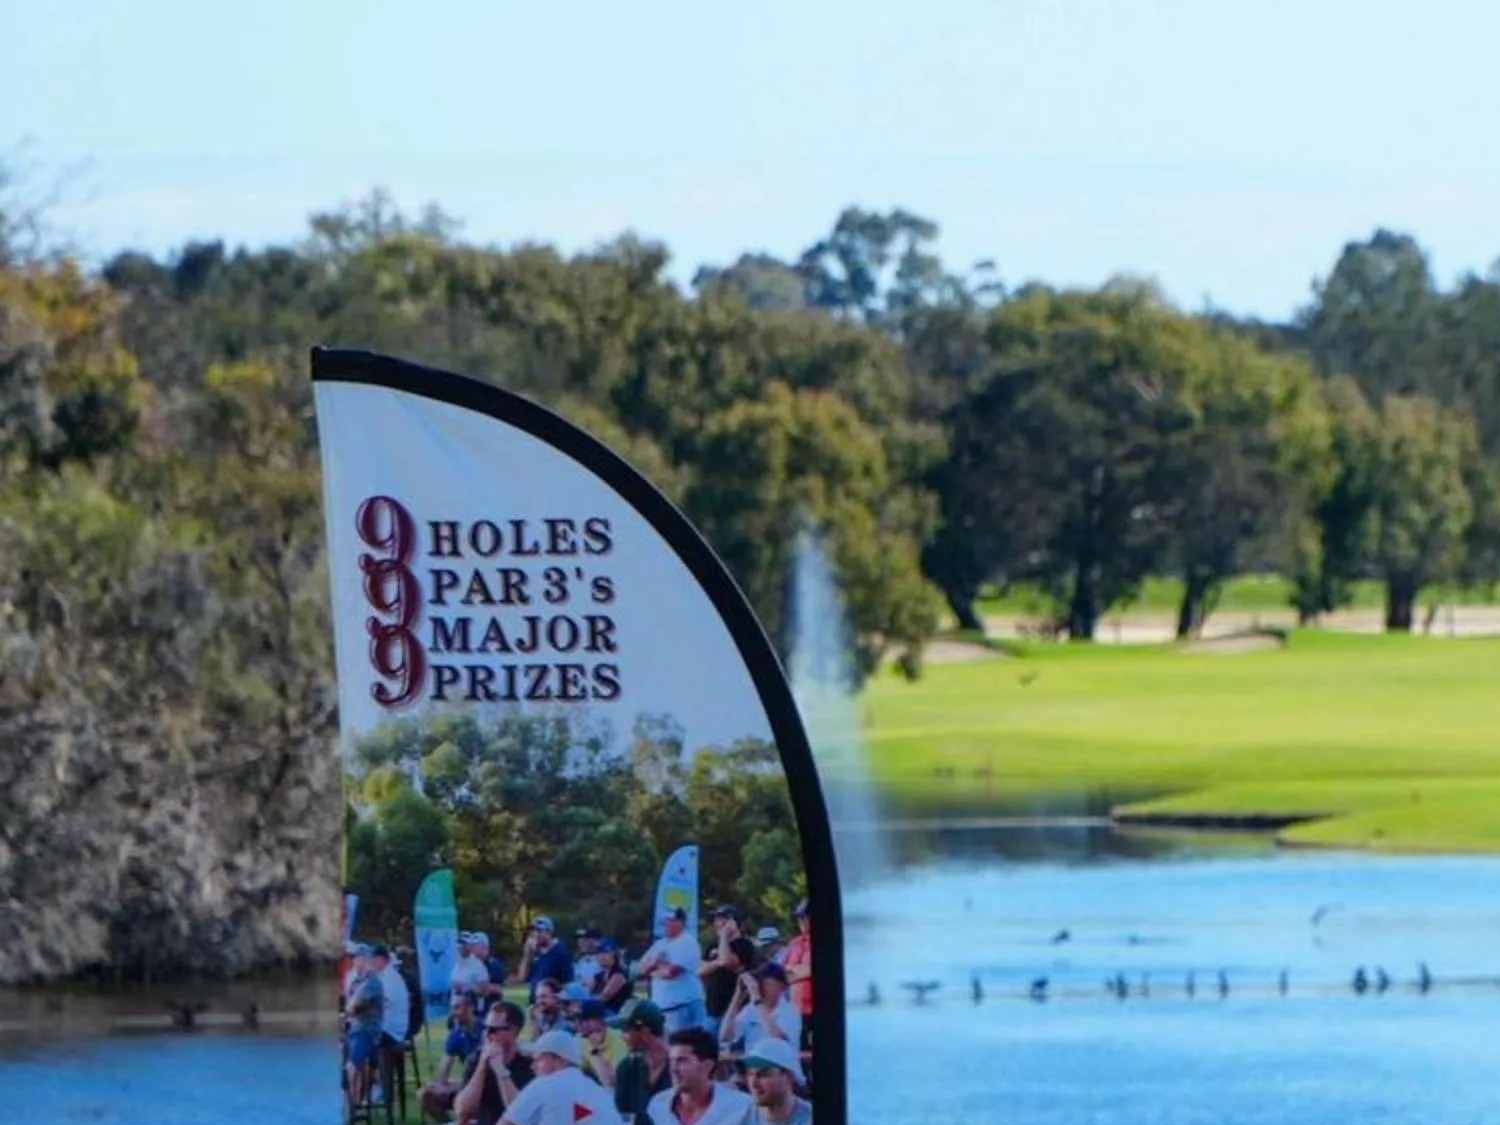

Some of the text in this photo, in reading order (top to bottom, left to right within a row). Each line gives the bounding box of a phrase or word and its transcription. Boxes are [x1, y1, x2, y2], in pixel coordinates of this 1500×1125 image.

[355, 495, 614, 573] 9 HOLES
[363, 557, 423, 640] 9
[369, 614, 619, 709] 9 MAJOR
[428, 663, 622, 702] PRIZES
